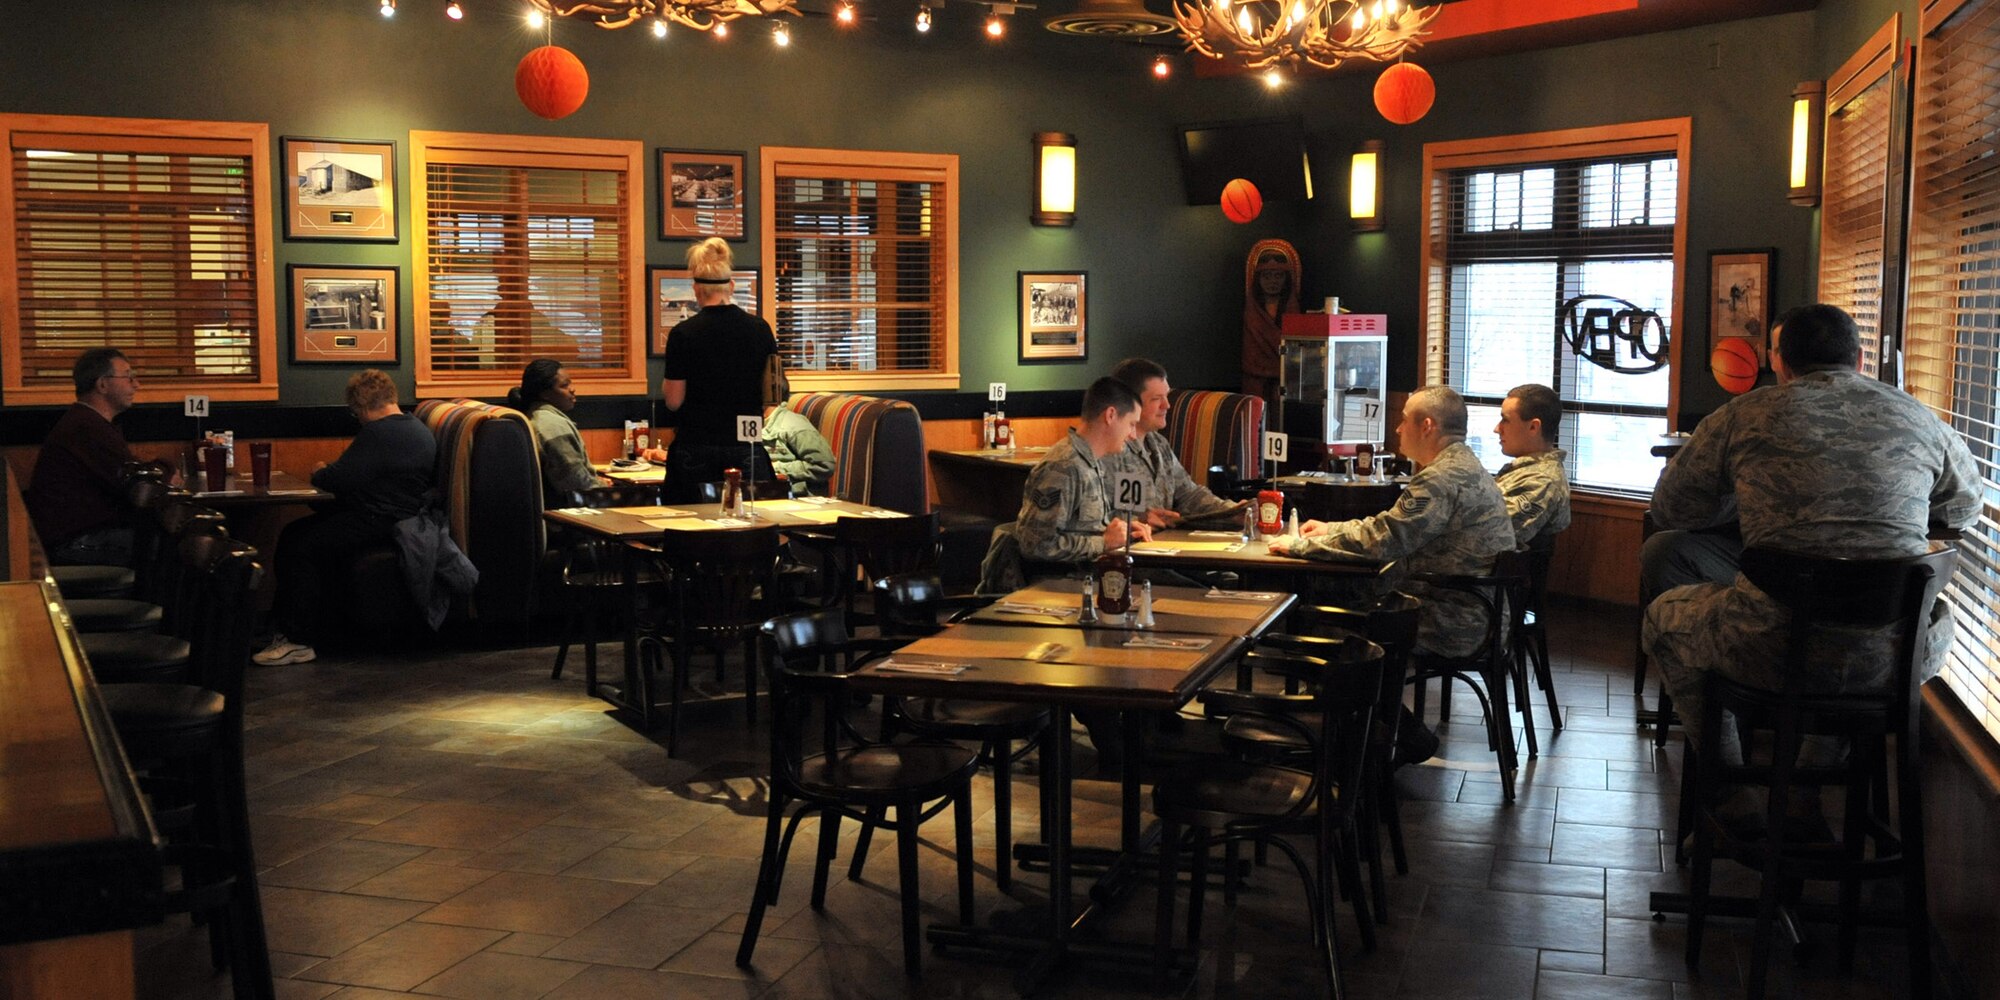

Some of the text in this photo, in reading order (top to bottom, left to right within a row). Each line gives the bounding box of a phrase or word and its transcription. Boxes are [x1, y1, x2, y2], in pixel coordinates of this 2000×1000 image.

[992, 385, 1003, 398] 16
[189, 399, 204, 414] 14
[1365, 403, 1379, 418] 17
[742, 420, 757, 437] 18
[1269, 437, 1283, 456] 19
[1120, 478, 1142, 505] 20
